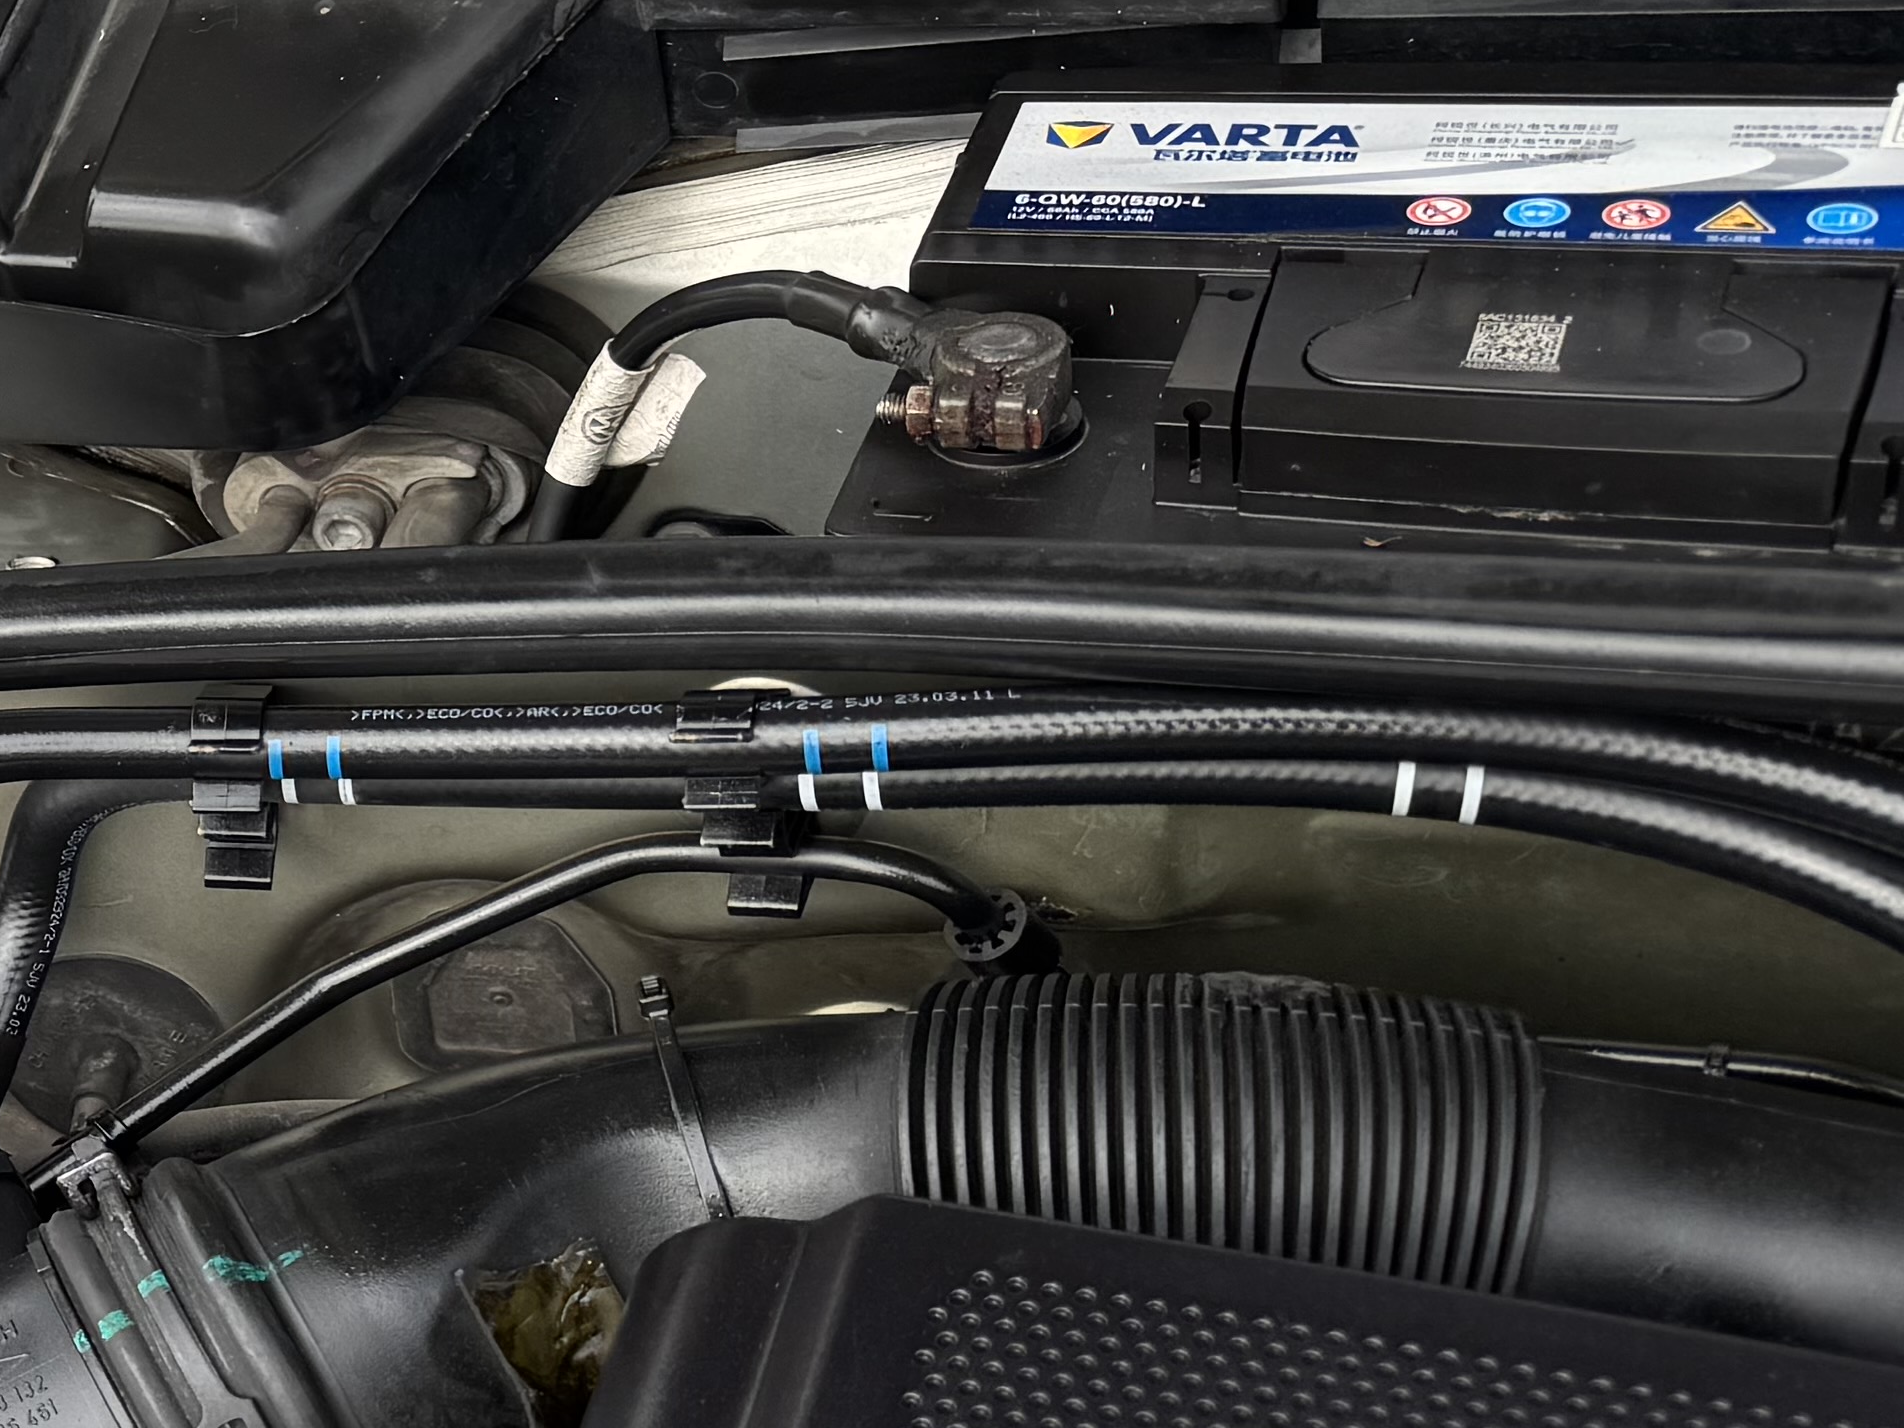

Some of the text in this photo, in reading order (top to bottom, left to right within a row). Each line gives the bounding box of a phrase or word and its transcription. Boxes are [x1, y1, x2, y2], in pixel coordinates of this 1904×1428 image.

[1130, 123, 1361, 148] VARTA
[1015, 193, 1206, 208] 6-QW-60(580)-L
[894, 689, 995, 704] 23.03.11
[16, 1374, 50, 1405] 132
